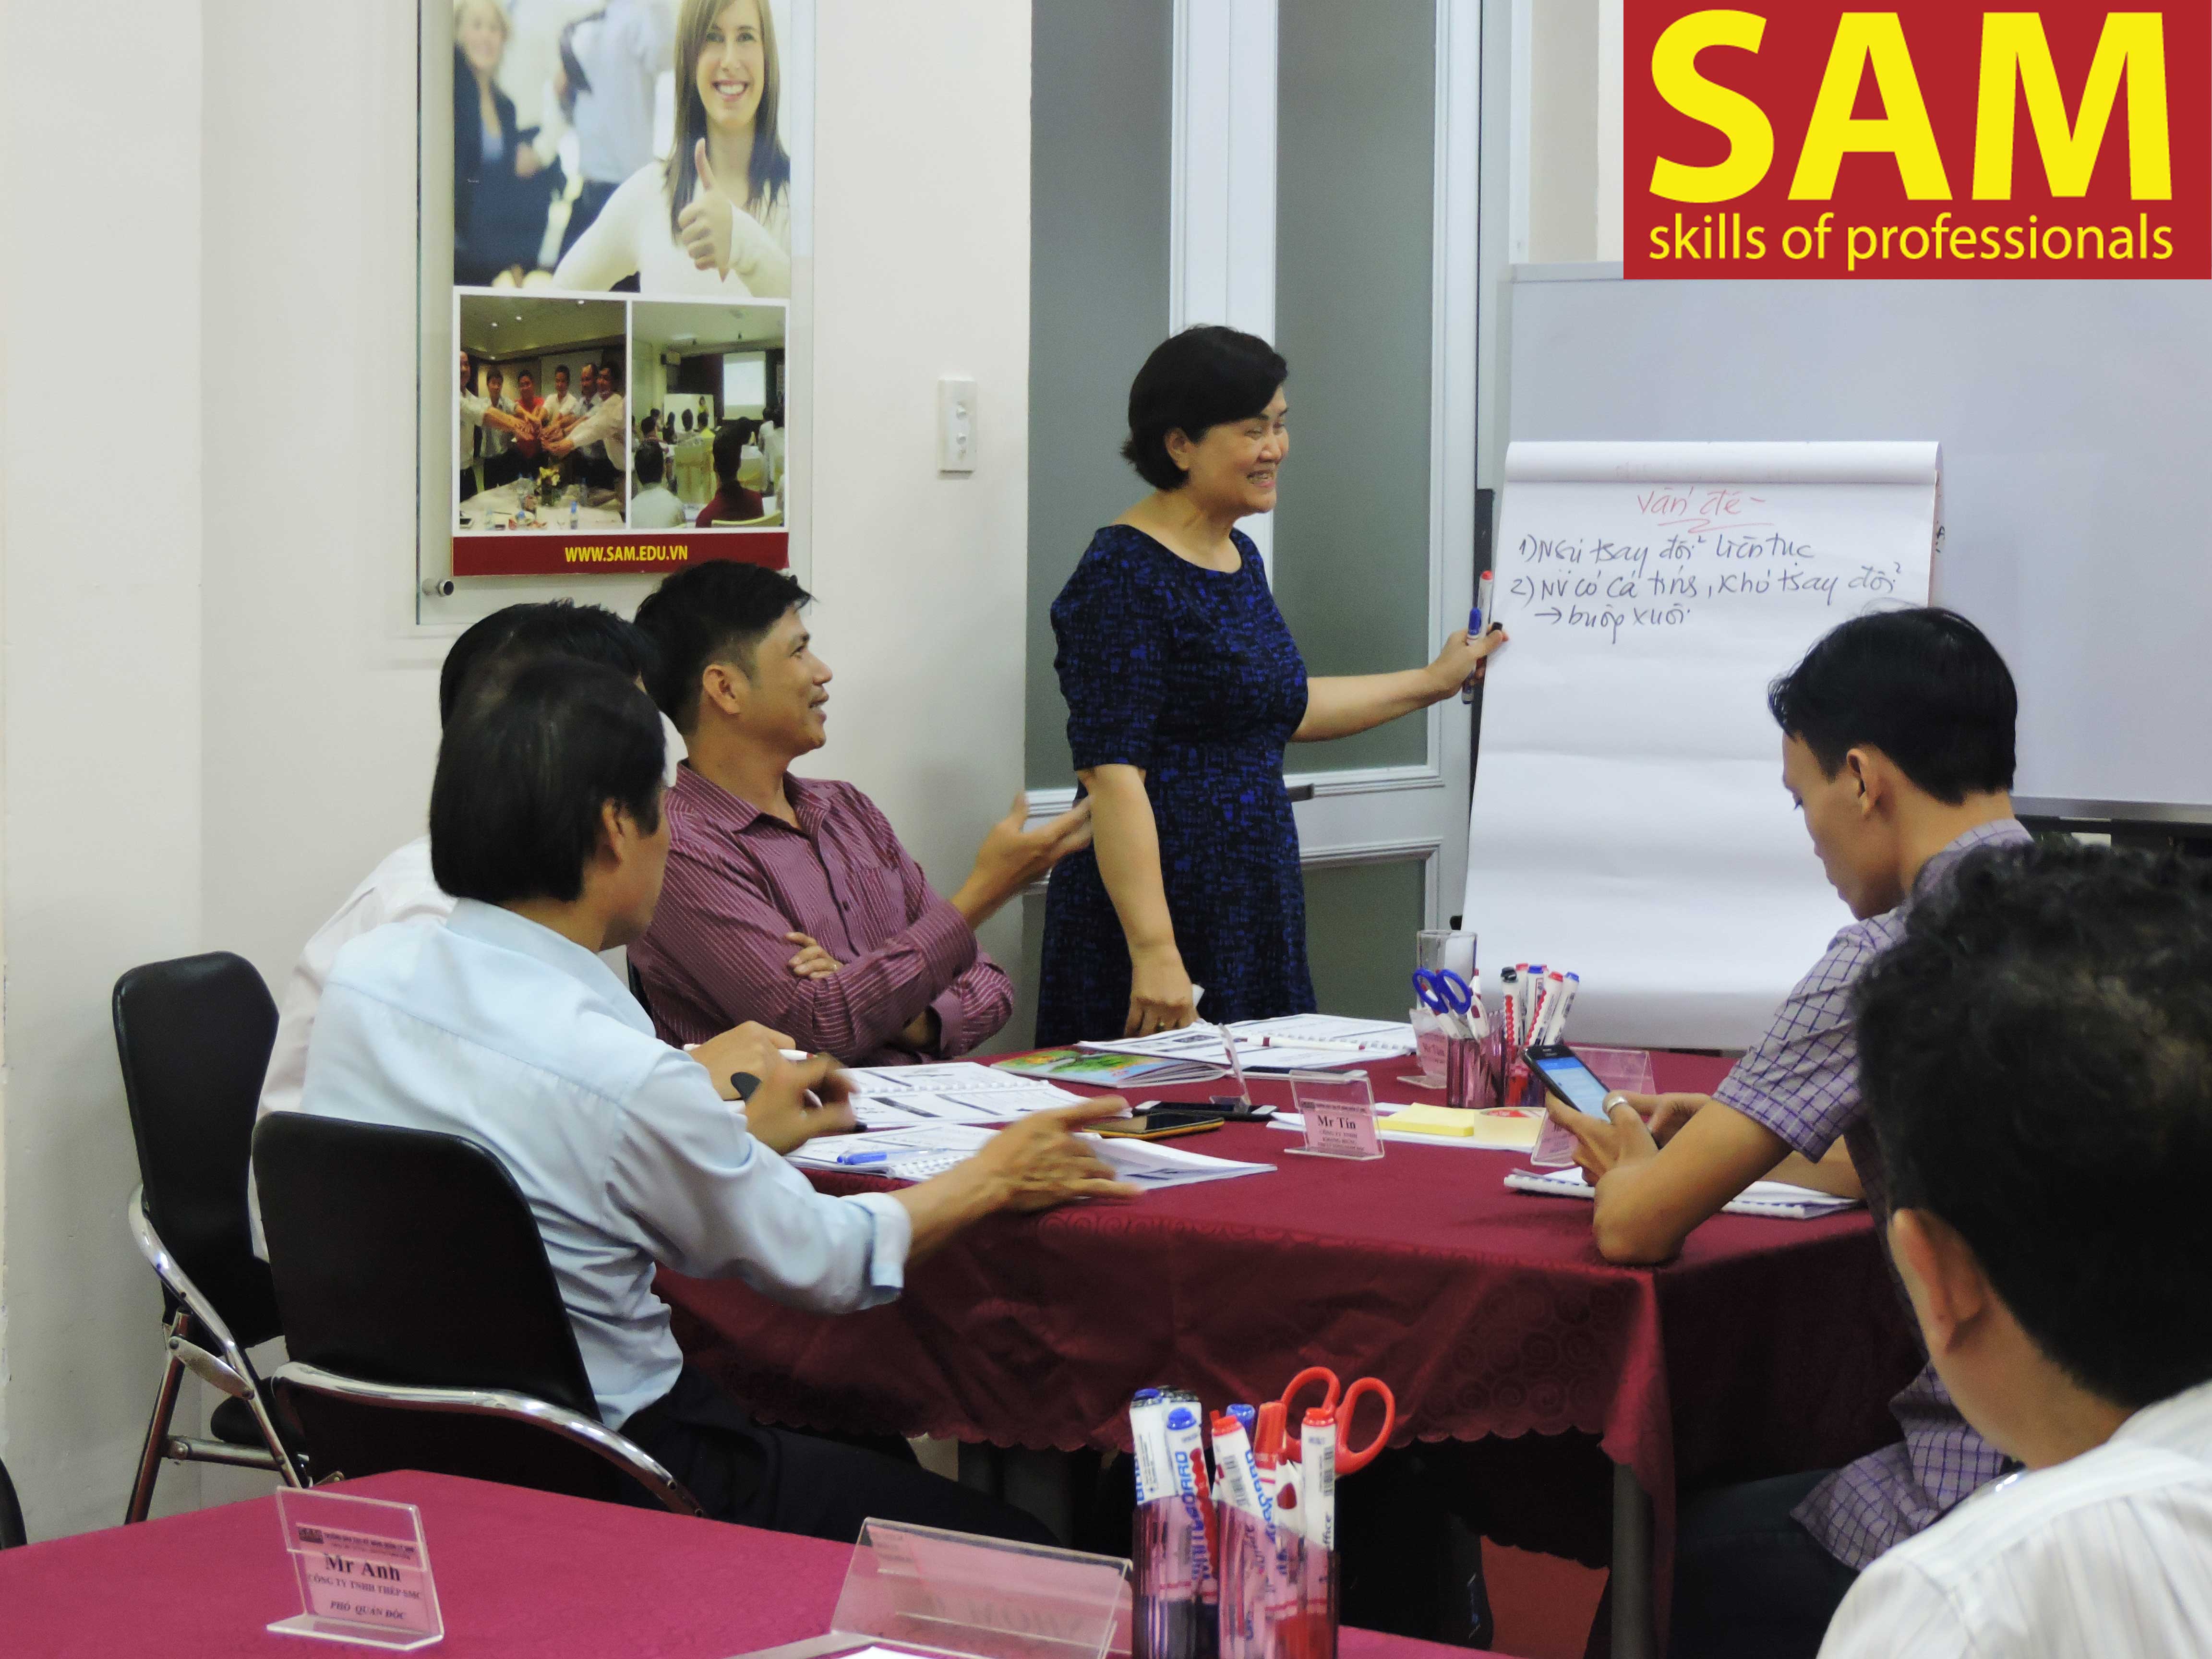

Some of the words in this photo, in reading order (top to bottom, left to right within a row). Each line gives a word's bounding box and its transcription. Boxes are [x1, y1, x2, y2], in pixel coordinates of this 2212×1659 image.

[565, 545, 688, 562] WWW.SAM.EDU.VN
[1317, 1115, 1334, 1127] Mr
[325, 1553, 354, 1574] Mr
